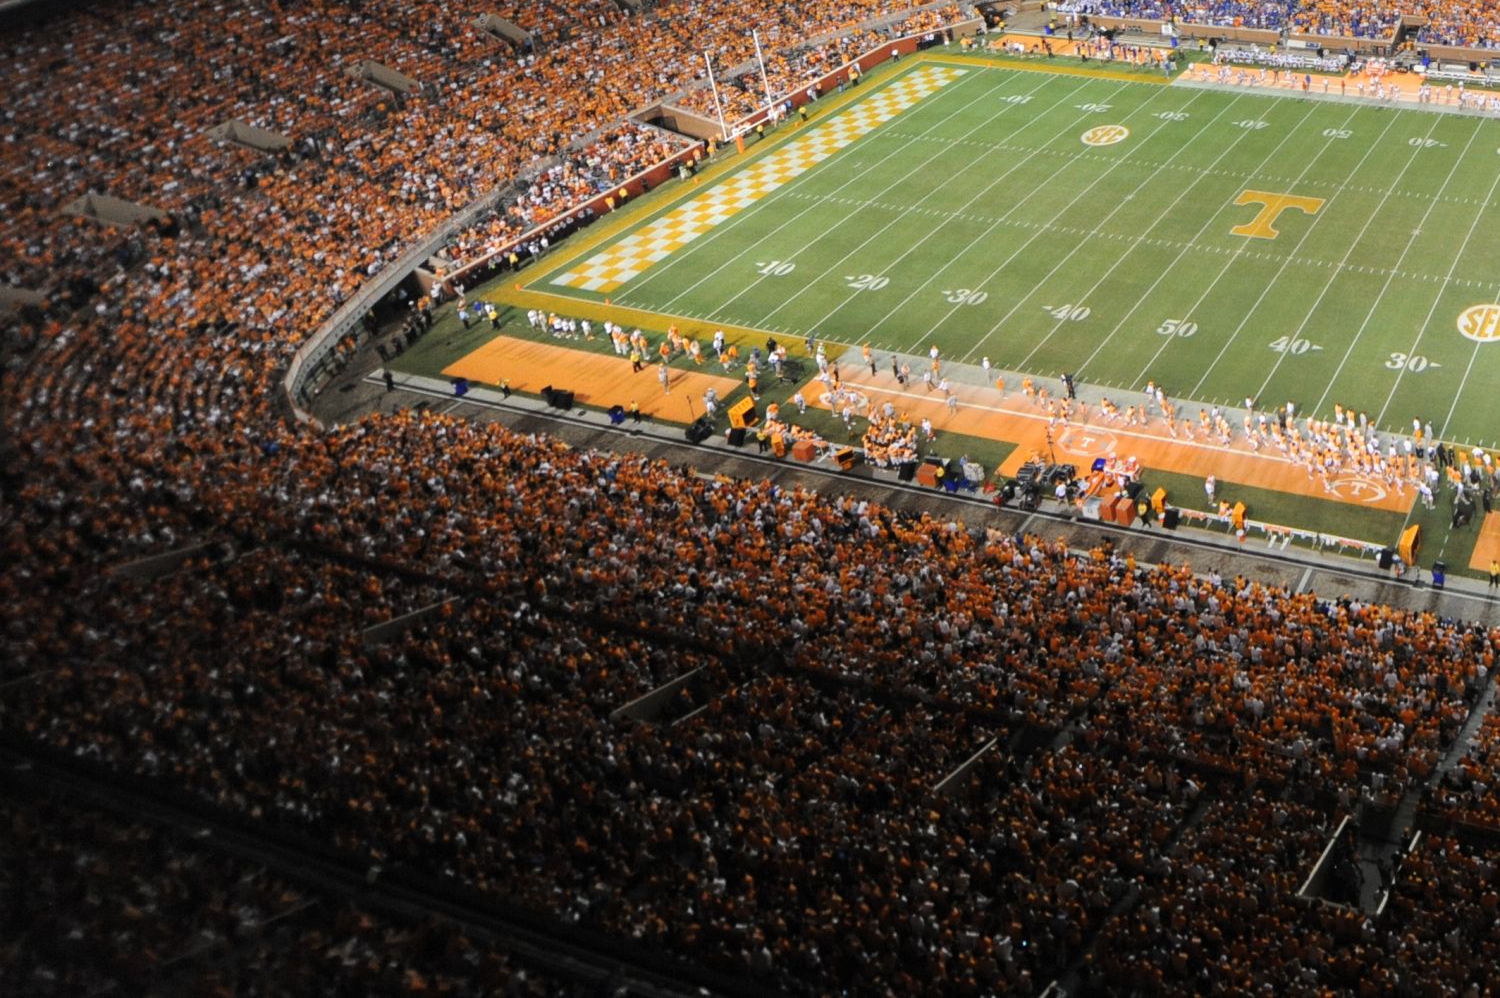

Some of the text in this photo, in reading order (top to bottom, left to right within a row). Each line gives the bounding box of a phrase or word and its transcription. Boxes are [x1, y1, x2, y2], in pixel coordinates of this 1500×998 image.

[1085, 125, 1124, 144] SEC
[1322, 128, 1353, 139] 50
[1229, 189, 1326, 240] T
[758, 260, 796, 276] 10
[847, 274, 890, 291] 20
[947, 289, 988, 306] 30
[1051, 304, 1091, 321] 40
[1157, 319, 1198, 337] 50
[1268, 335, 1310, 355] 40
[1385, 352, 1428, 373] 30
